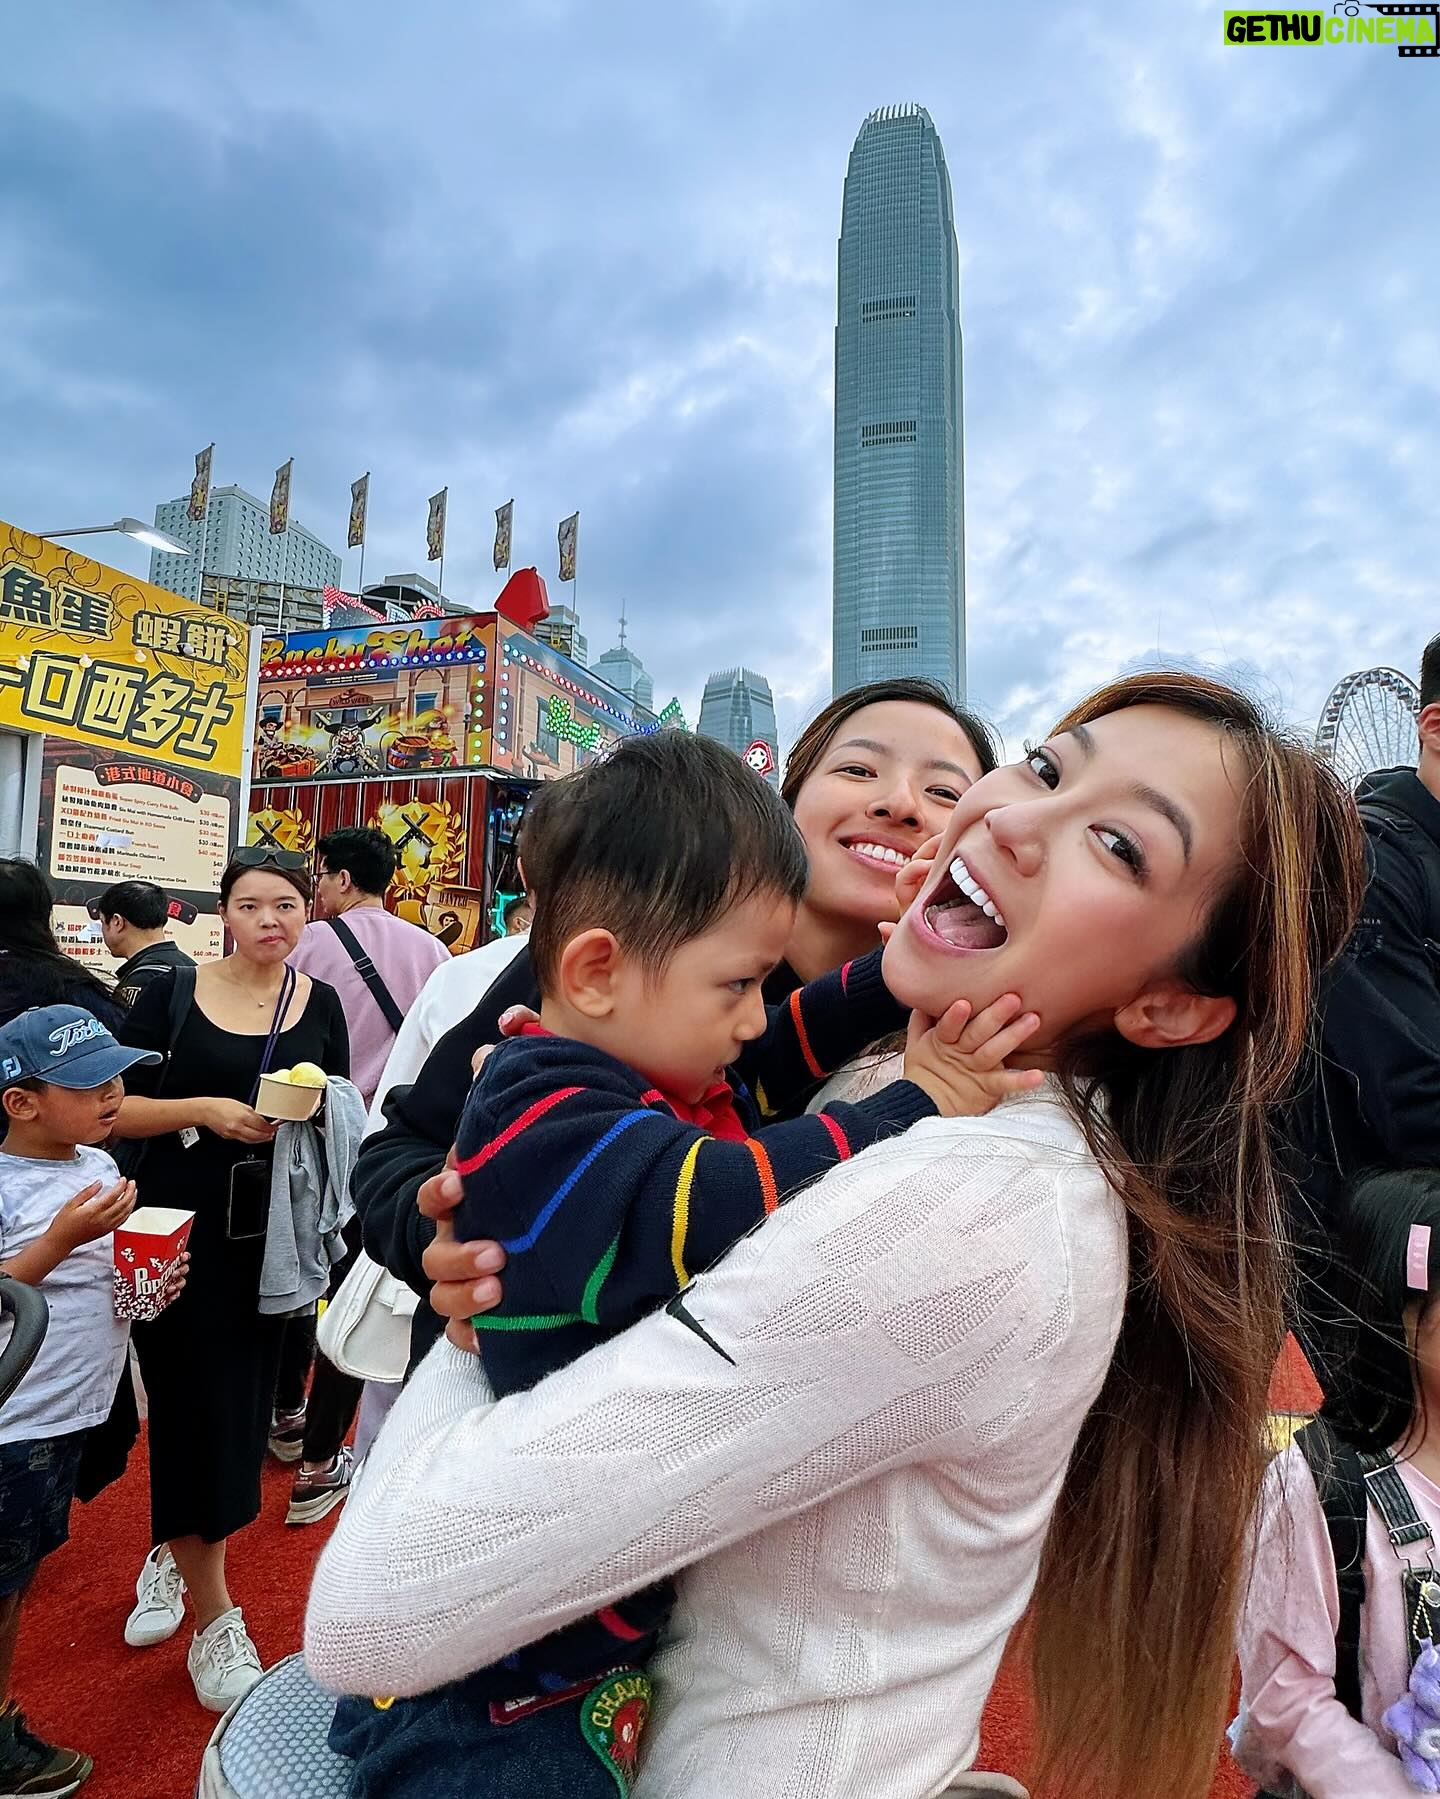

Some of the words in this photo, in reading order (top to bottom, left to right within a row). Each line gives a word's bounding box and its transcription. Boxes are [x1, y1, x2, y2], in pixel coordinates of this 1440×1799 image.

[0, 565, 111, 638] 魚蛋
[136, 614, 228, 664] 蝦餅
[368, 628, 473, 663] Shot
[2, 1055, 22, 1080] FJ
